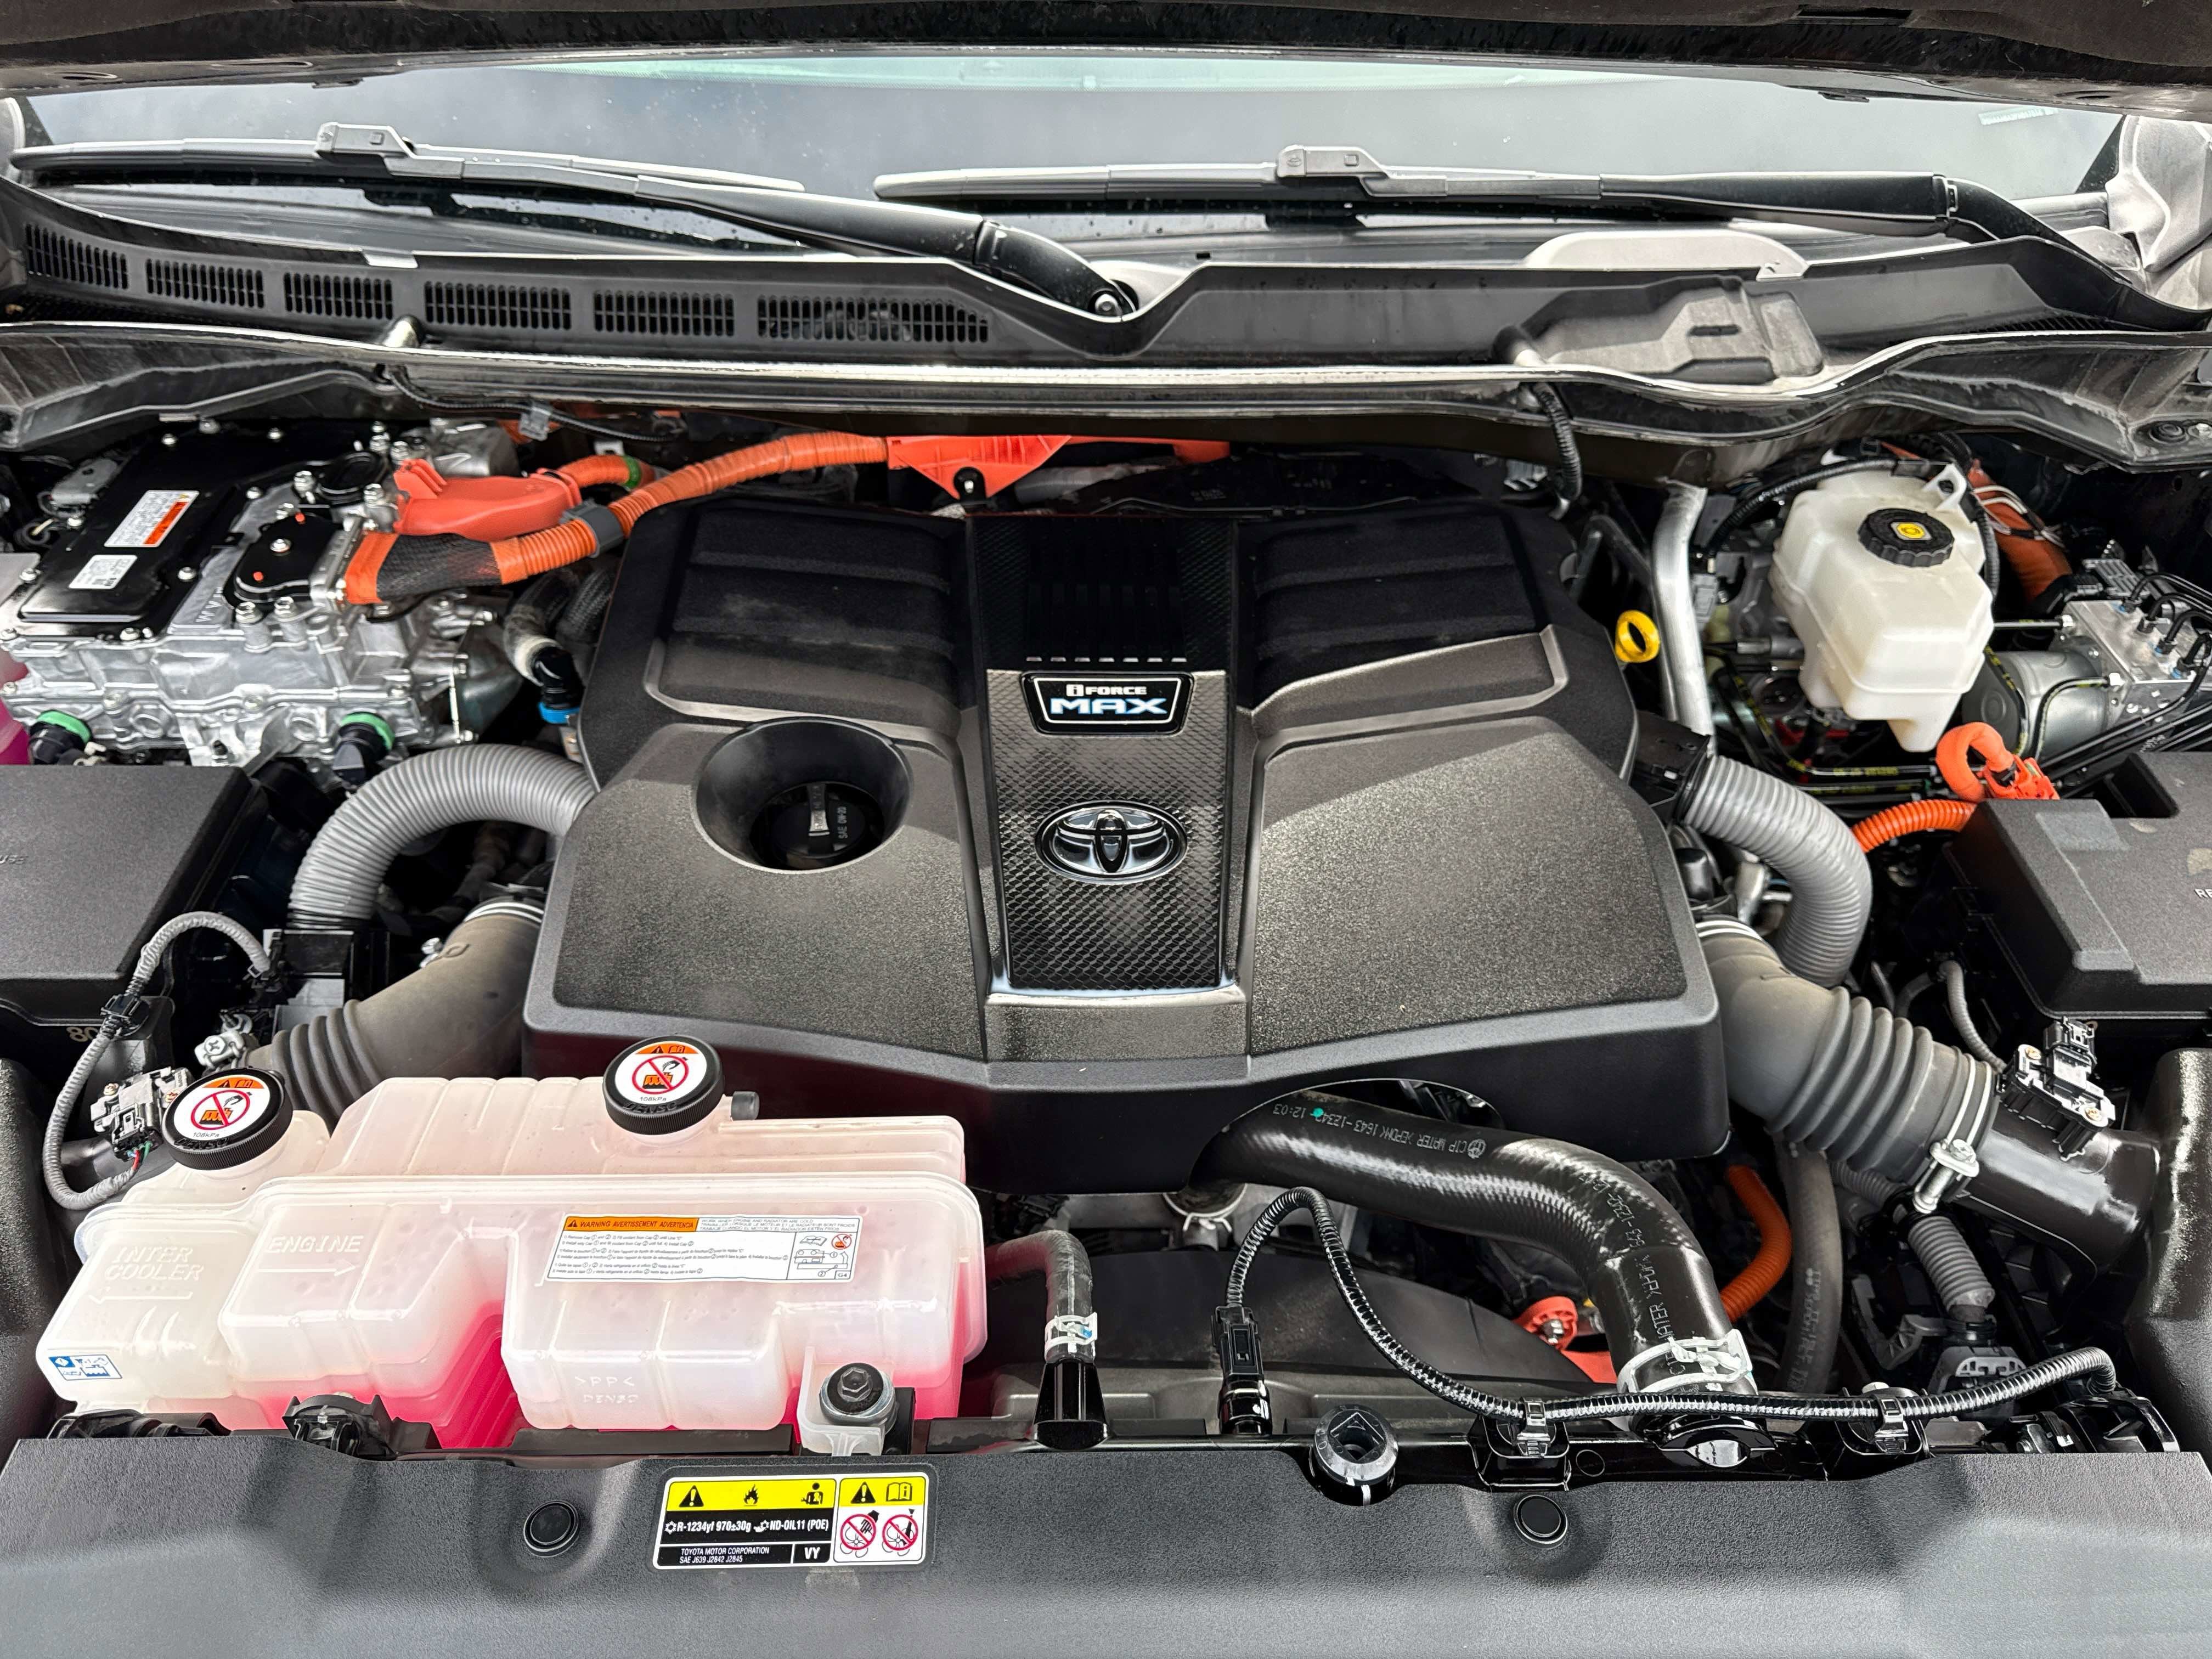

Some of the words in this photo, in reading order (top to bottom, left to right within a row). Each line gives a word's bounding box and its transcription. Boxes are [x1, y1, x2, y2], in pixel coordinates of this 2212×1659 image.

[1050, 697, 1168, 714] MAX
[1272, 1103, 1307, 1120] 12:03
[268, 1235, 364, 1254] ENGINE
[111, 1245, 194, 1263] INTER
[104, 1263, 204, 1281] COOLER
[676, 1521, 715, 1533] R-1234yf
[716, 1520, 752, 1533] 970±30g
[769, 1519, 805, 1531] ND-OIL11
[807, 1519, 829, 1532] (POE)
[727, 1547, 770, 1555] CORPORATION
[804, 1547, 821, 1559] VY
